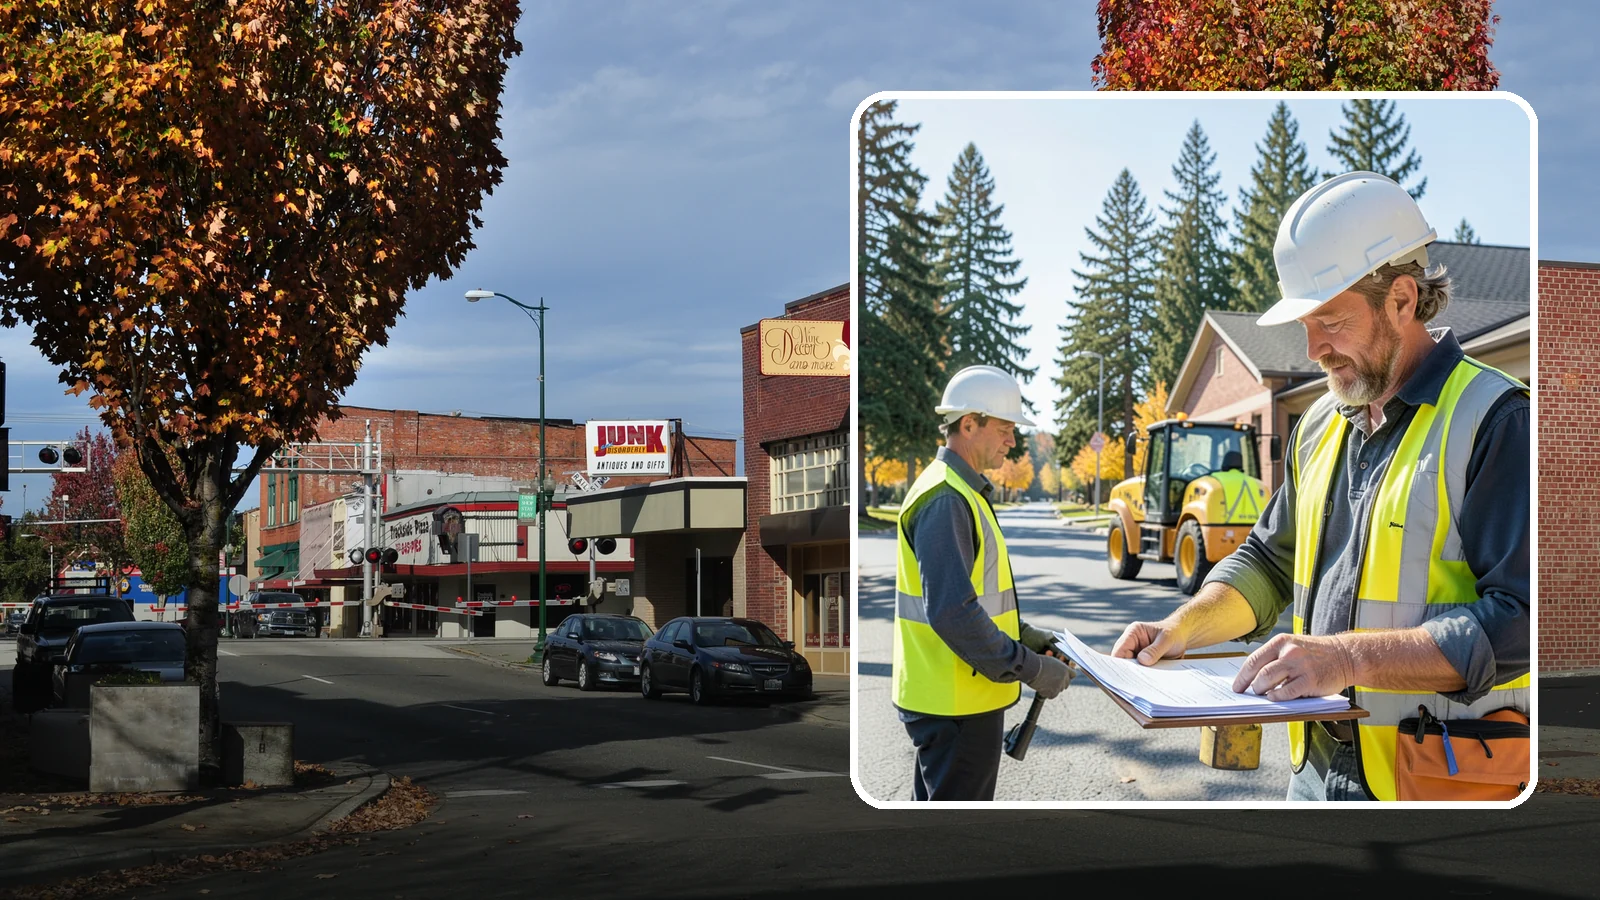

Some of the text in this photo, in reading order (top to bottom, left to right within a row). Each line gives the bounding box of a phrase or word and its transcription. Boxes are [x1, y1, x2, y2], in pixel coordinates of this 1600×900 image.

[595, 425, 665, 457] JUNK
[607, 446, 646, 454] DISORDERLY
[596, 460, 665, 470] ANTIQUES AND GIFTS
[414, 519, 429, 535] Pizza
